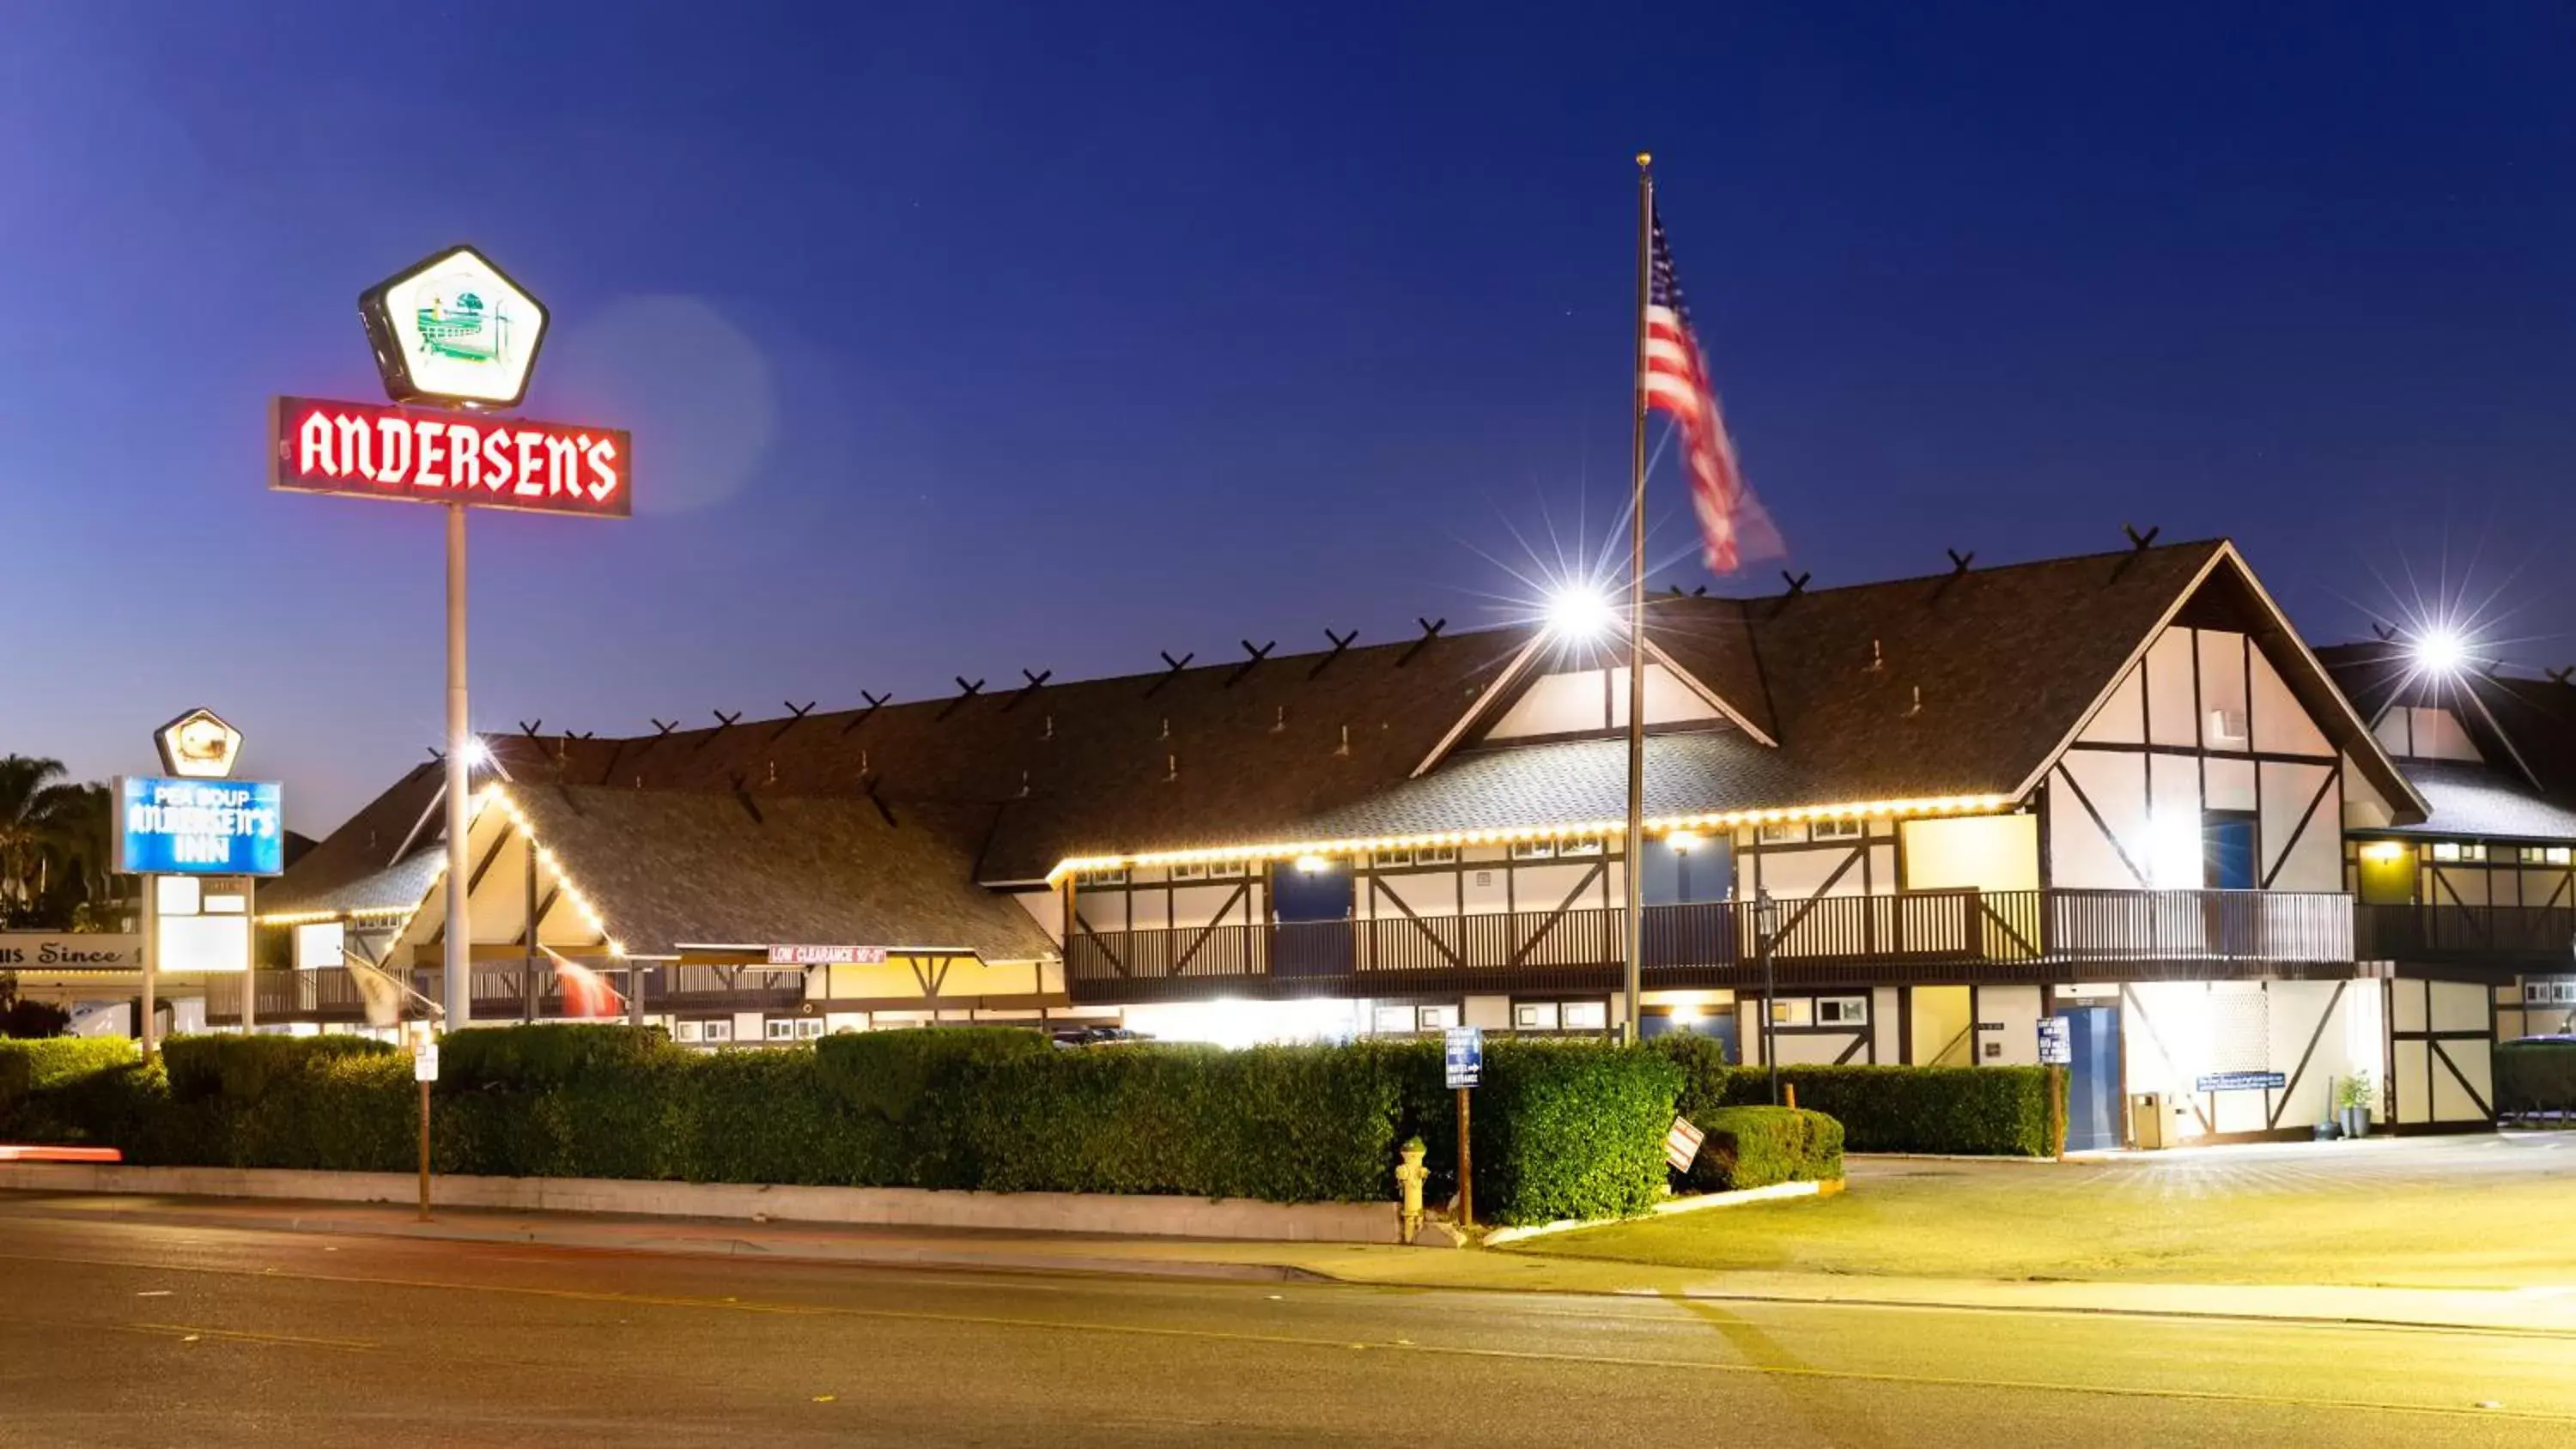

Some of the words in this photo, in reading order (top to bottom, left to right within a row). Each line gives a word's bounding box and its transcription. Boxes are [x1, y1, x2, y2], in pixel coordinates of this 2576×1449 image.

[301, 410, 617, 502] ANDERSEN'S
[175, 835, 229, 863] INN
[38, 943, 123, 964] Since
[772, 946, 793, 961] LOW
[797, 947, 853, 962] CLEARANCE
